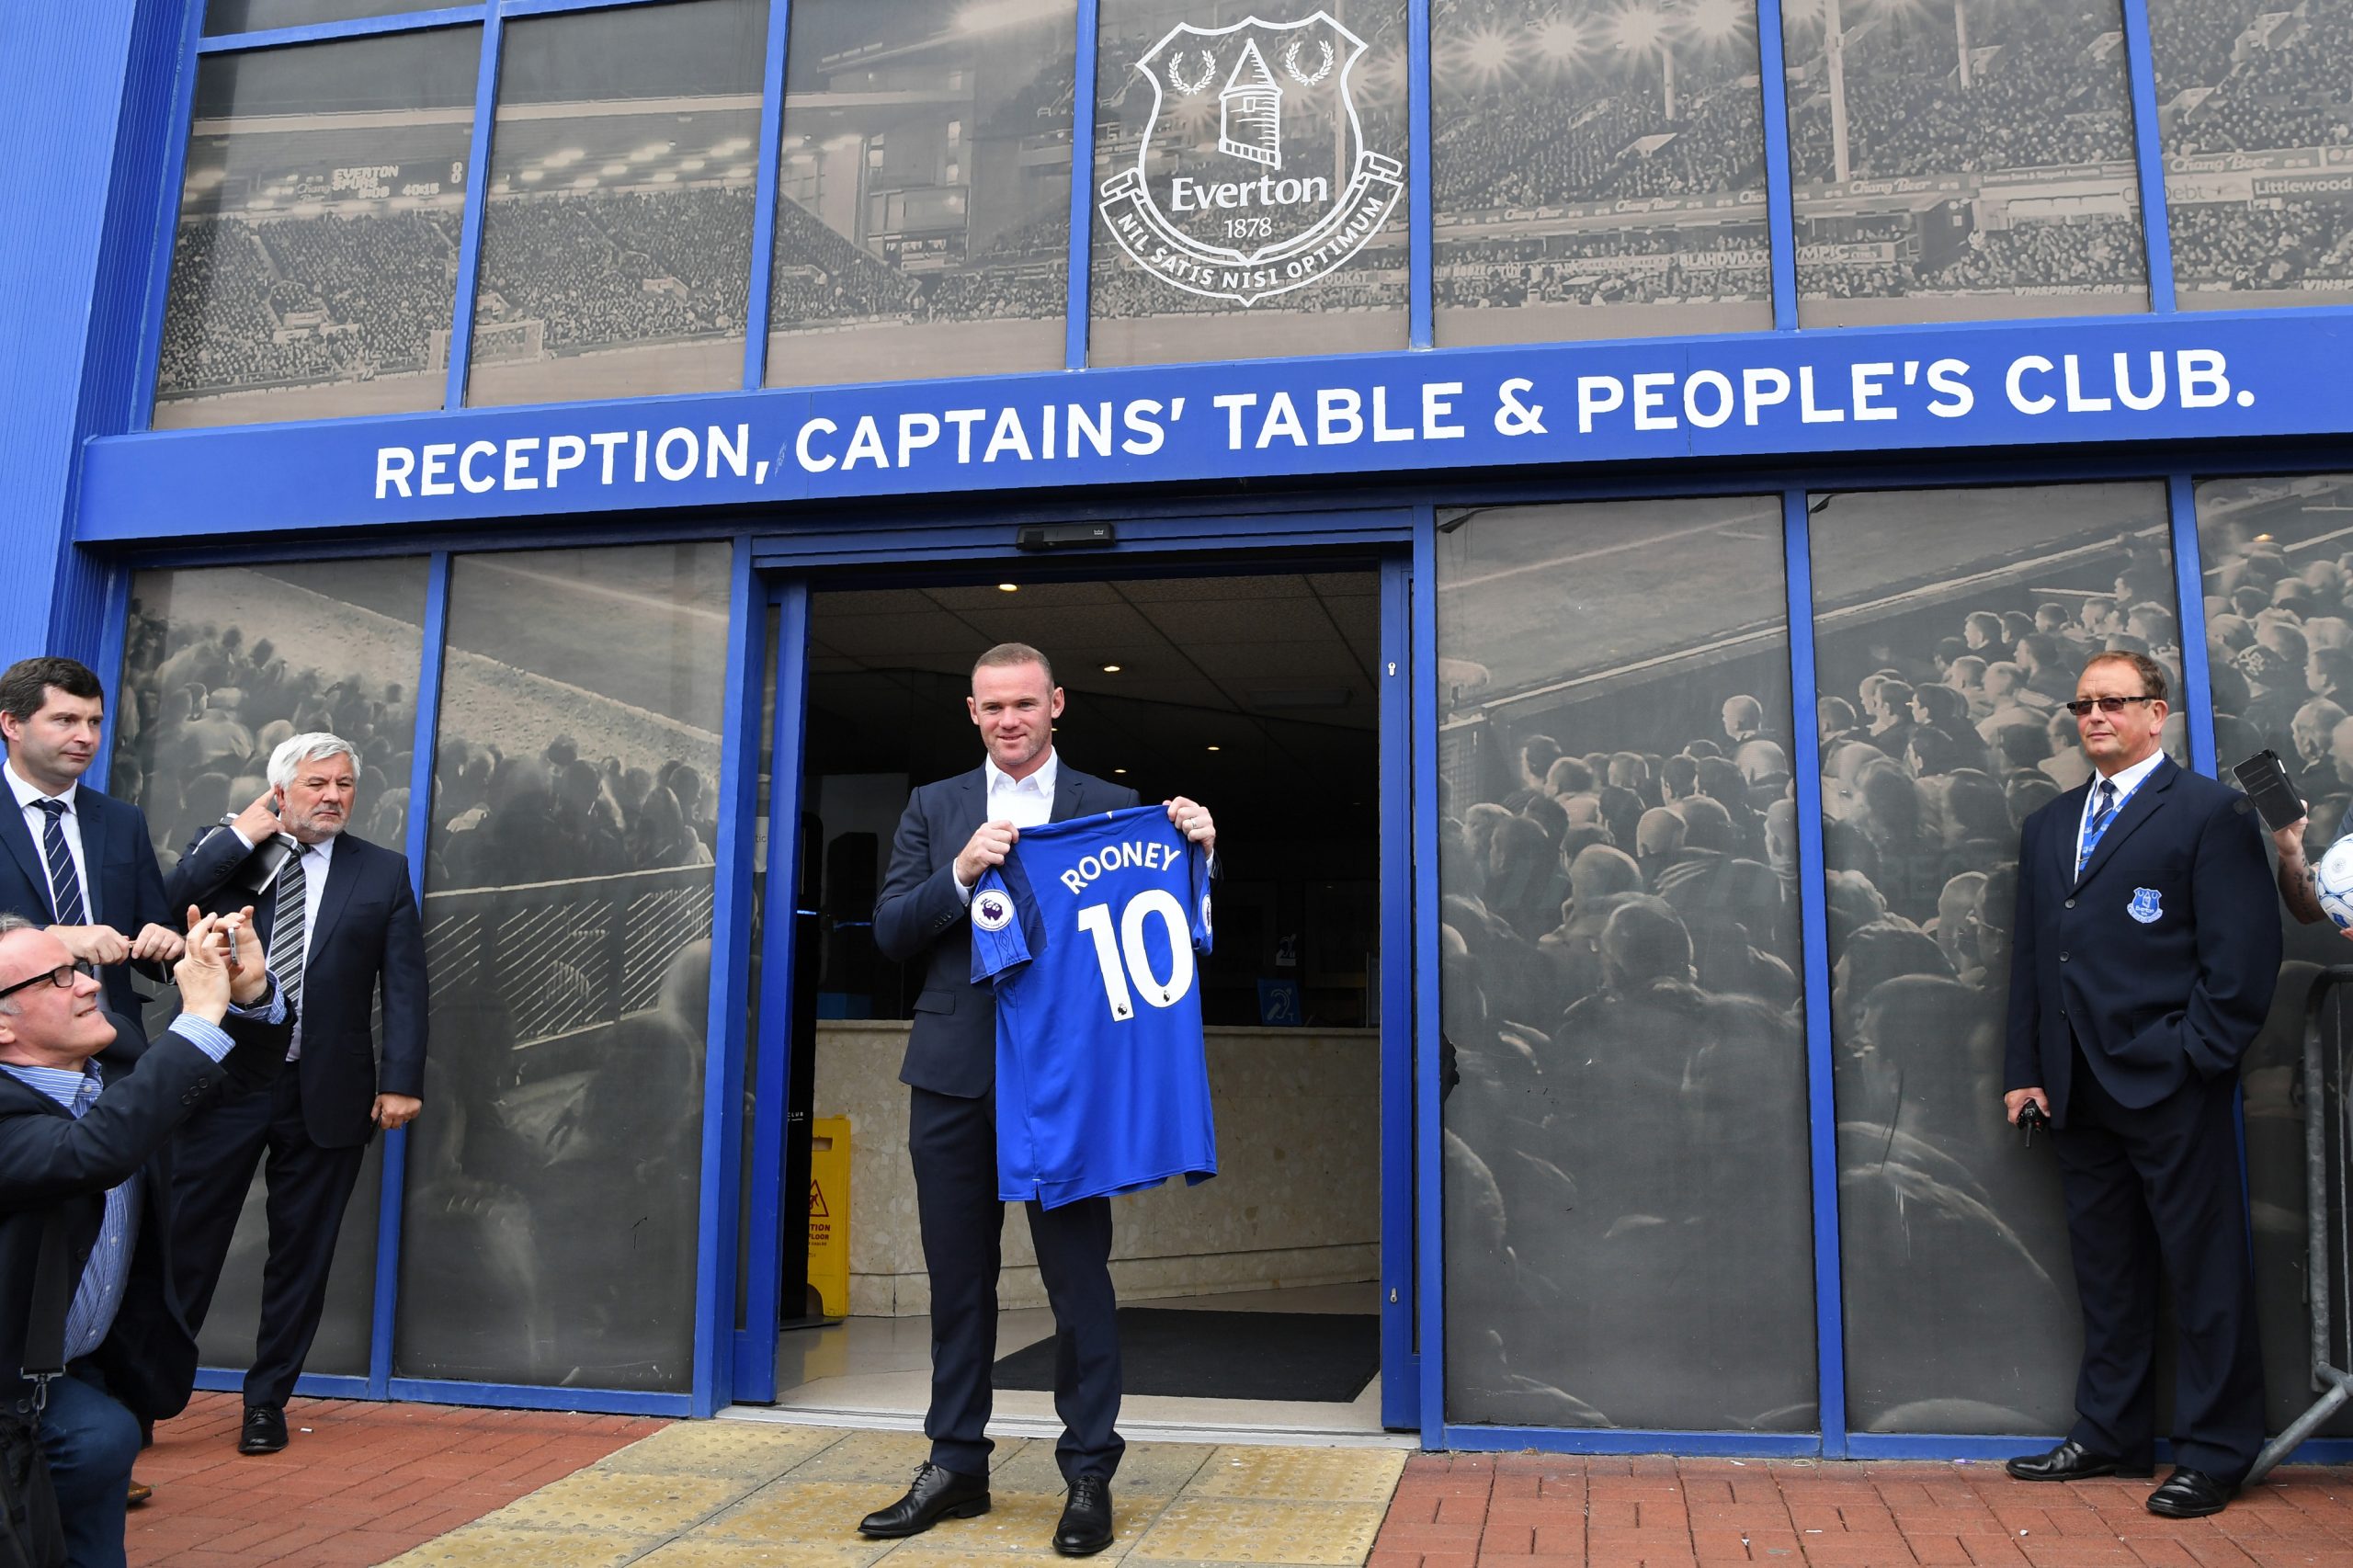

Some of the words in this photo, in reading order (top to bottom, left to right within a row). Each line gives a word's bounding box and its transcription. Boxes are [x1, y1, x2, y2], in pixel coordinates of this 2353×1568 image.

[334, 165, 399, 178] EVERTON
[2170, 156, 2225, 173] Chang
[2225, 154, 2275, 170] Beer
[1172, 176, 1327, 211] Everton
[1850, 180, 1893, 196] Chang
[1893, 177, 1932, 192] Beer
[1223, 216, 1273, 239] 1878
[1117, 212, 1145, 253] NIL
[1151, 246, 1215, 287] SATIS
[1222, 271, 1279, 290] NISI
[1286, 196, 1384, 278] OPTIMUM
[1796, 245, 1849, 261] YMPIC
[1678, 250, 1770, 267] BLAHDVD.CO
[375, 423, 769, 499] RECEPTION,
[1213, 381, 1465, 450] TABLE
[1494, 378, 1549, 437] &
[2005, 348, 2255, 415] CLUB.
[1060, 841, 1181, 895] ROONEY
[1077, 889, 1194, 1023] 10
[810, 1223, 831, 1232] TION
